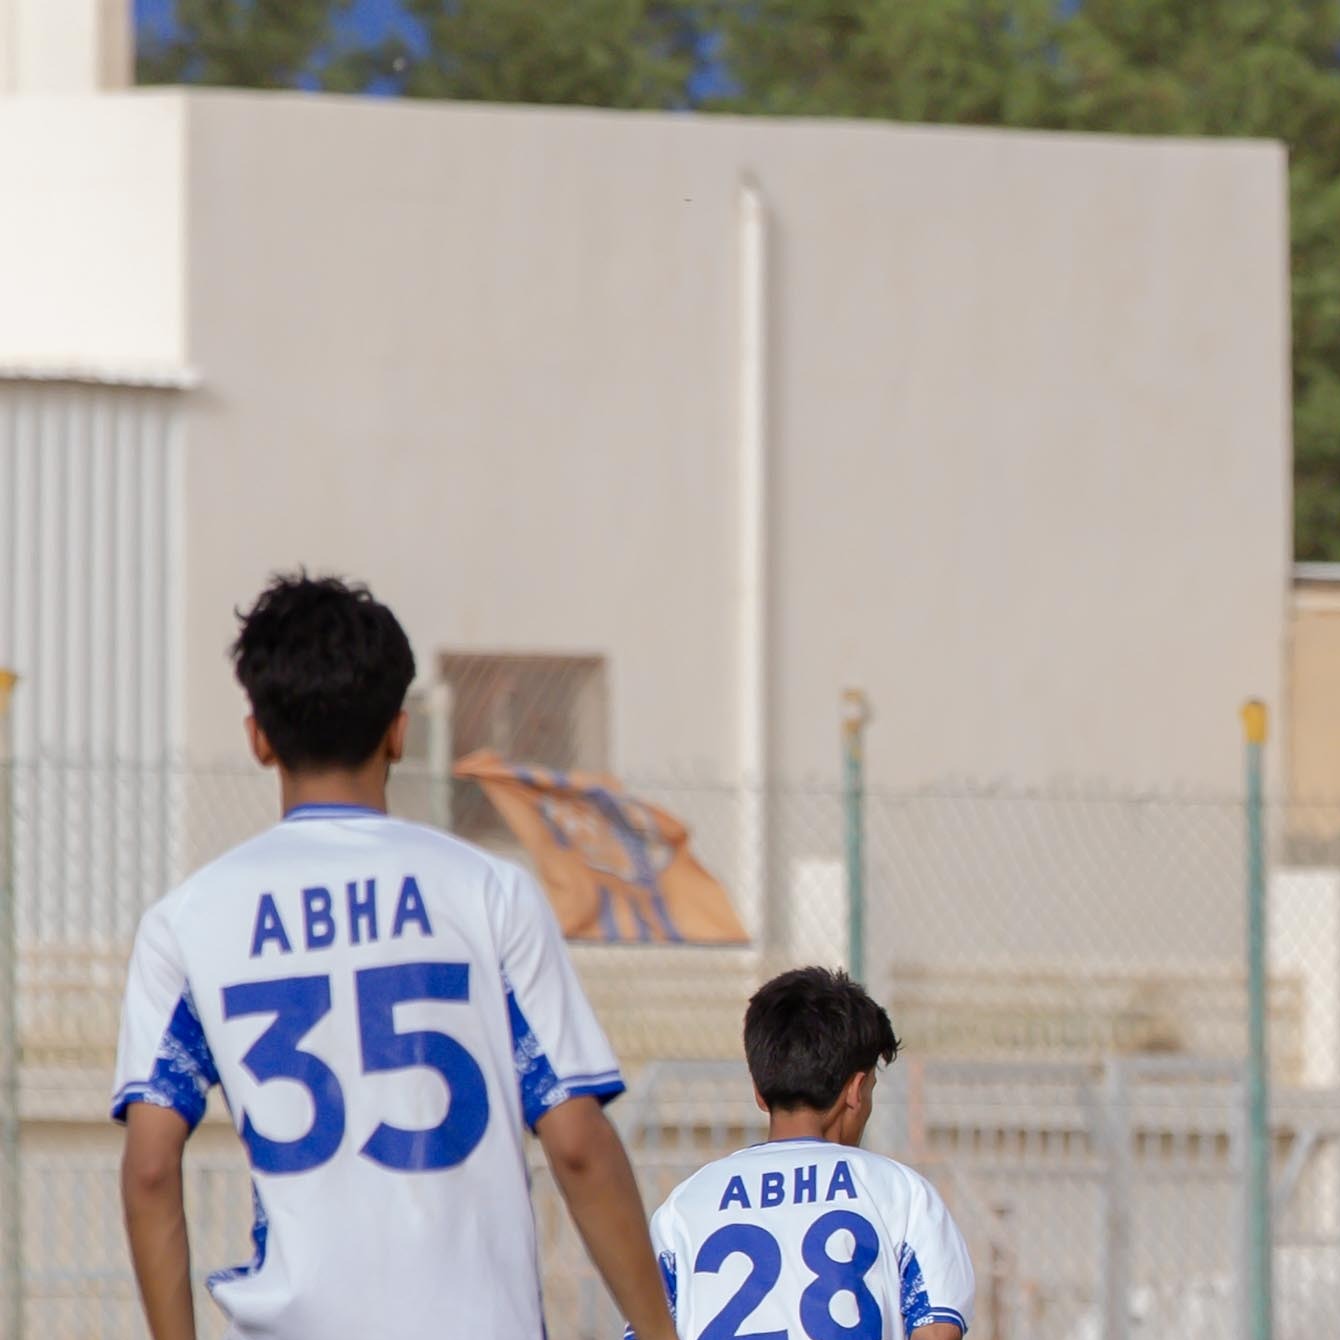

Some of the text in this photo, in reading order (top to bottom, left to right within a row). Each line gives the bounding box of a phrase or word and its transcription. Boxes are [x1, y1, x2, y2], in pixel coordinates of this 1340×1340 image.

[250, 876, 434, 958] ABHA
[221, 962, 490, 1175] 35
[719, 1160, 858, 1211] ABHA
